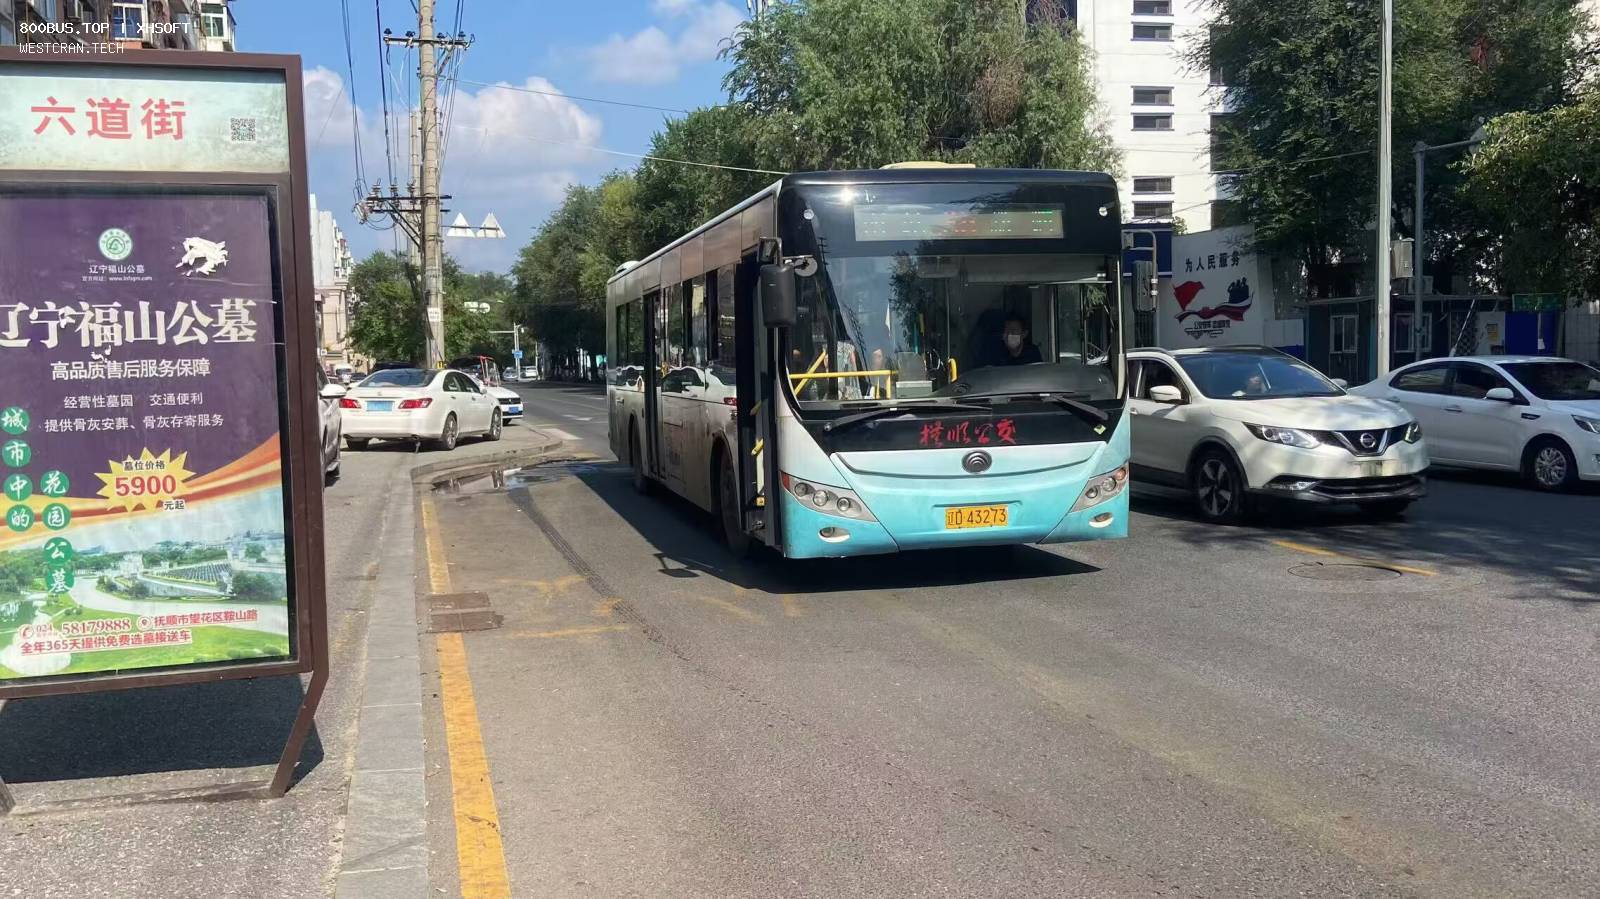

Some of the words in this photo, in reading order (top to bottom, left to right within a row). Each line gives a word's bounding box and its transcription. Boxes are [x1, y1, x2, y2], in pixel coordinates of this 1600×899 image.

[31, 96, 187, 140] 六道街
[89, 264, 145, 274] 辽宁福山公墓
[1184, 251, 1241, 273] 为人民服务
[0, 299, 256, 348] 辽宁福山公墓
[50, 359, 211, 381] 高品质售后服务保障
[63, 394, 134, 410] 经营性墓园
[149, 391, 203, 406] 交通便利
[44, 413, 225, 433] 提供骨灰安葬、骨灰存寄服务
[123, 460, 166, 471] 墓位价格
[114, 474, 177, 497] 5900
[163, 500, 186, 511] 元起
[62, 618, 131, 636] 58179888
